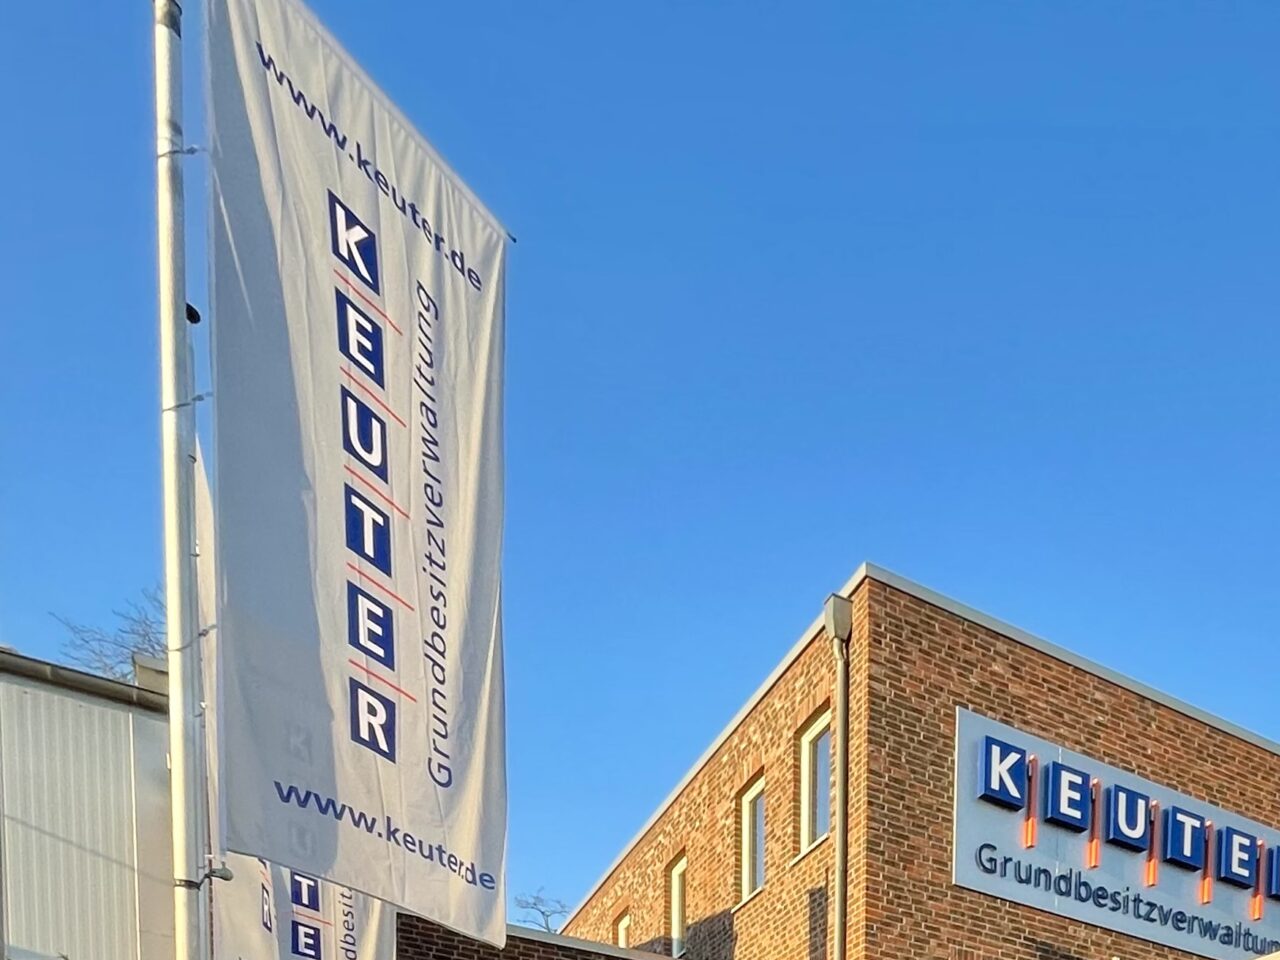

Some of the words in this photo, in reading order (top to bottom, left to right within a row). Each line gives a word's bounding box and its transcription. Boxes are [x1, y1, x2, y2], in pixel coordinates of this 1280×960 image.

[255, 40, 482, 292] www.keuter.de
[333, 198, 390, 746] KEUTER
[413, 279, 454, 789] Grundbesitzverwaltung
[273, 780, 496, 890] www.keuter.de
